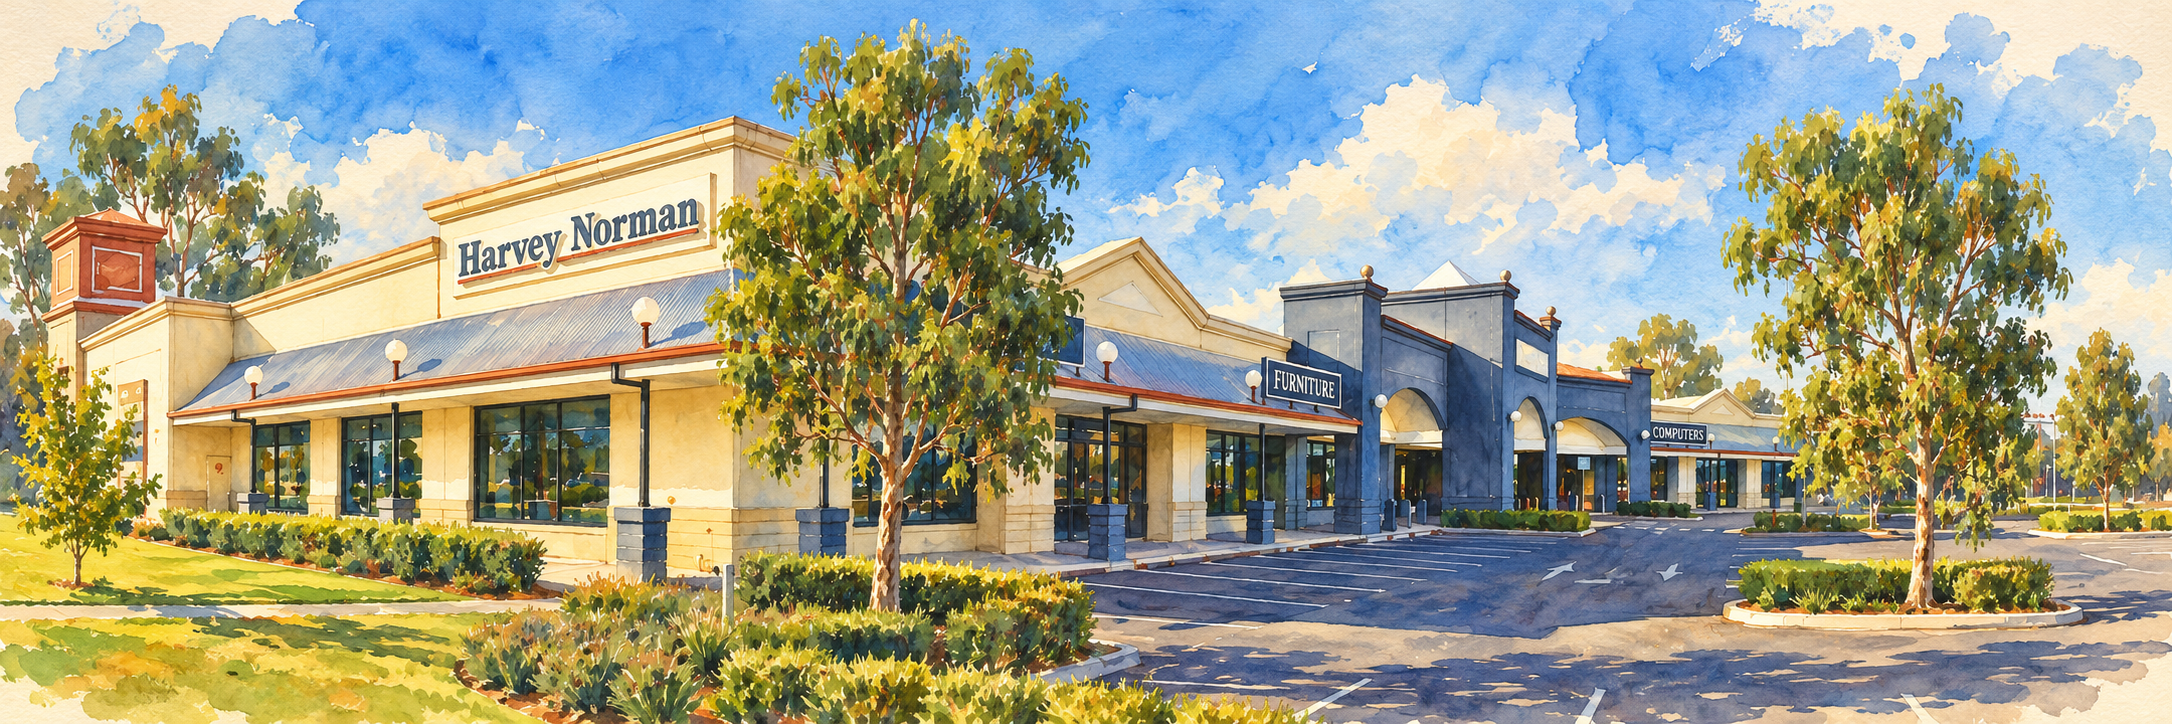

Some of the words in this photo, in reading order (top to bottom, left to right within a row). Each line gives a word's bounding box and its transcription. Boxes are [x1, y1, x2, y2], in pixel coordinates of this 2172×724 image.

[458, 230, 562, 277] Harvey
[570, 198, 699, 251] Norman
[1273, 369, 1335, 399] FURNITURE
[1652, 426, 1704, 441] COMPUTERS
